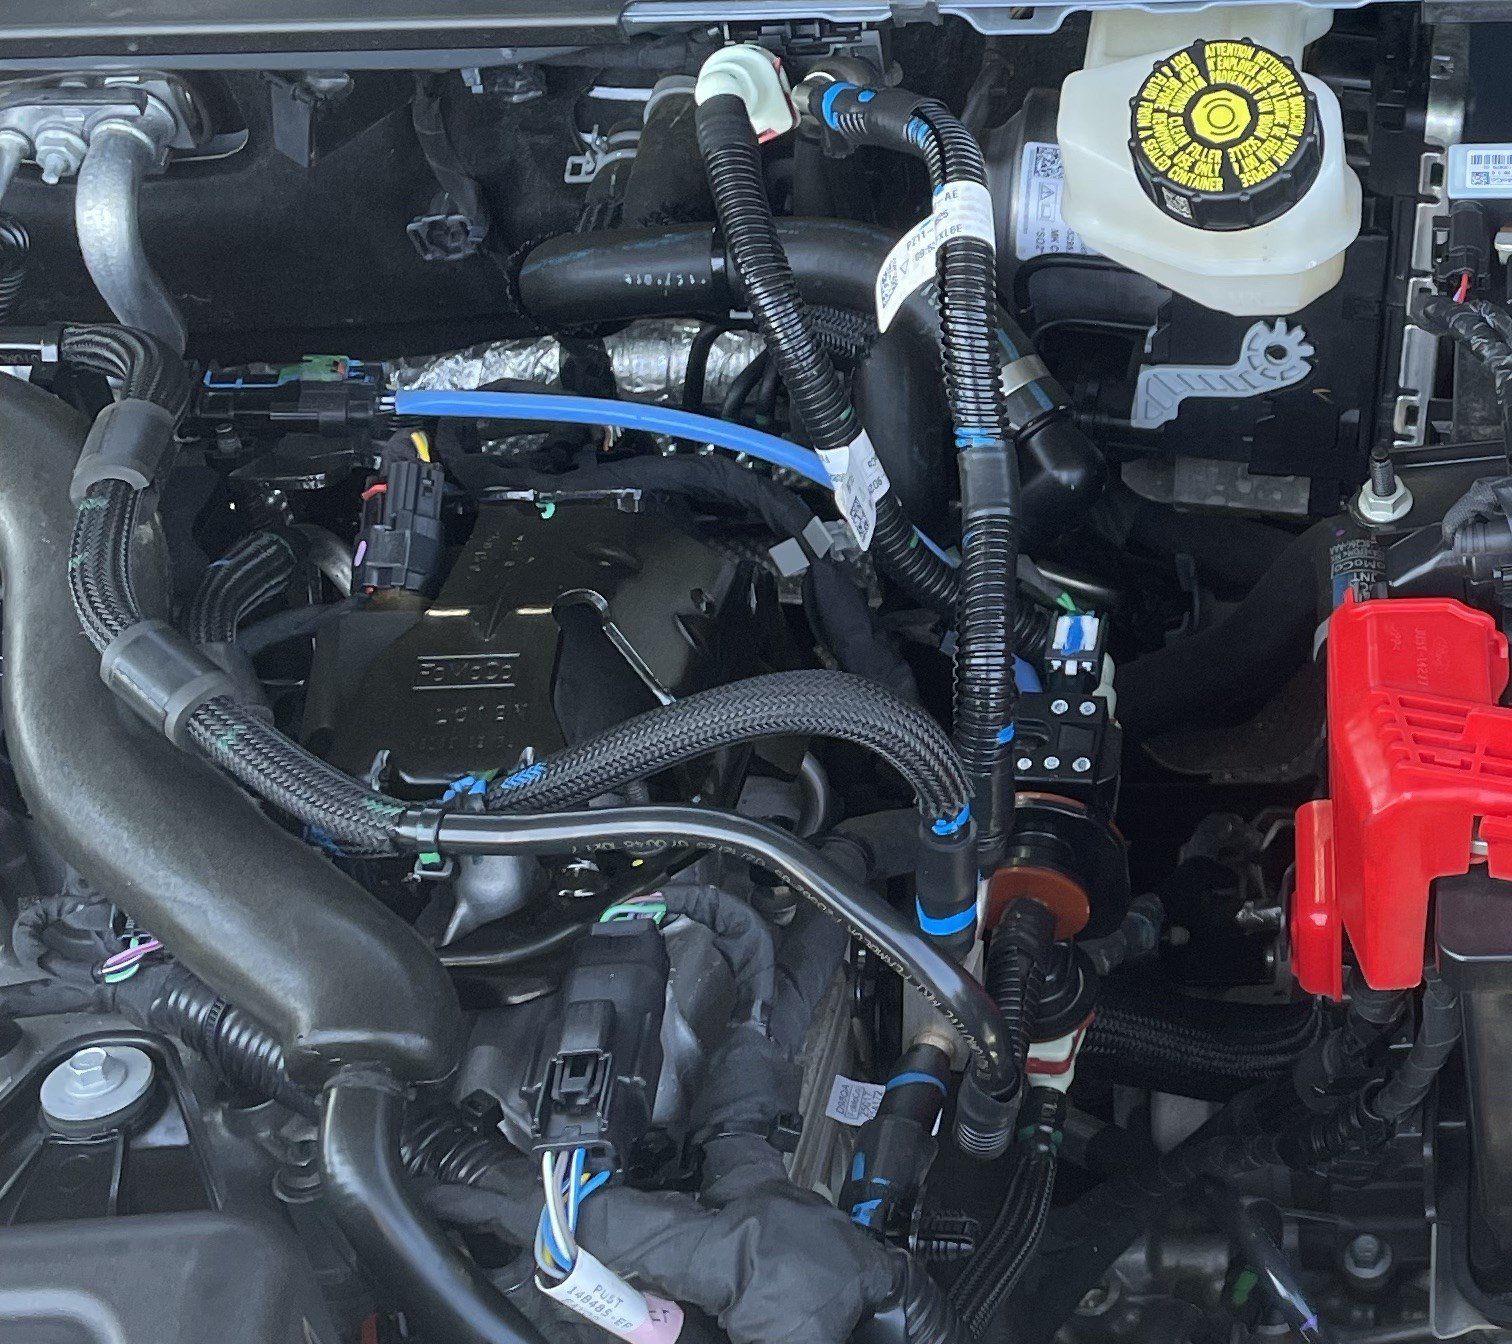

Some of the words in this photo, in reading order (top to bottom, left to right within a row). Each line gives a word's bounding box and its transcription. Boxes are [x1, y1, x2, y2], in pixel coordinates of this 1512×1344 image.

[1205, 42, 1255, 59] ATTENTION
[1168, 116, 1191, 147] CLEAN
[1185, 142, 1223, 163] FILLER
[1141, 138, 1171, 172] SEALED
[1167, 165, 1224, 192] CONTAINER
[1173, 151, 1195, 170] USE
[1194, 161, 1221, 177] ONLY
